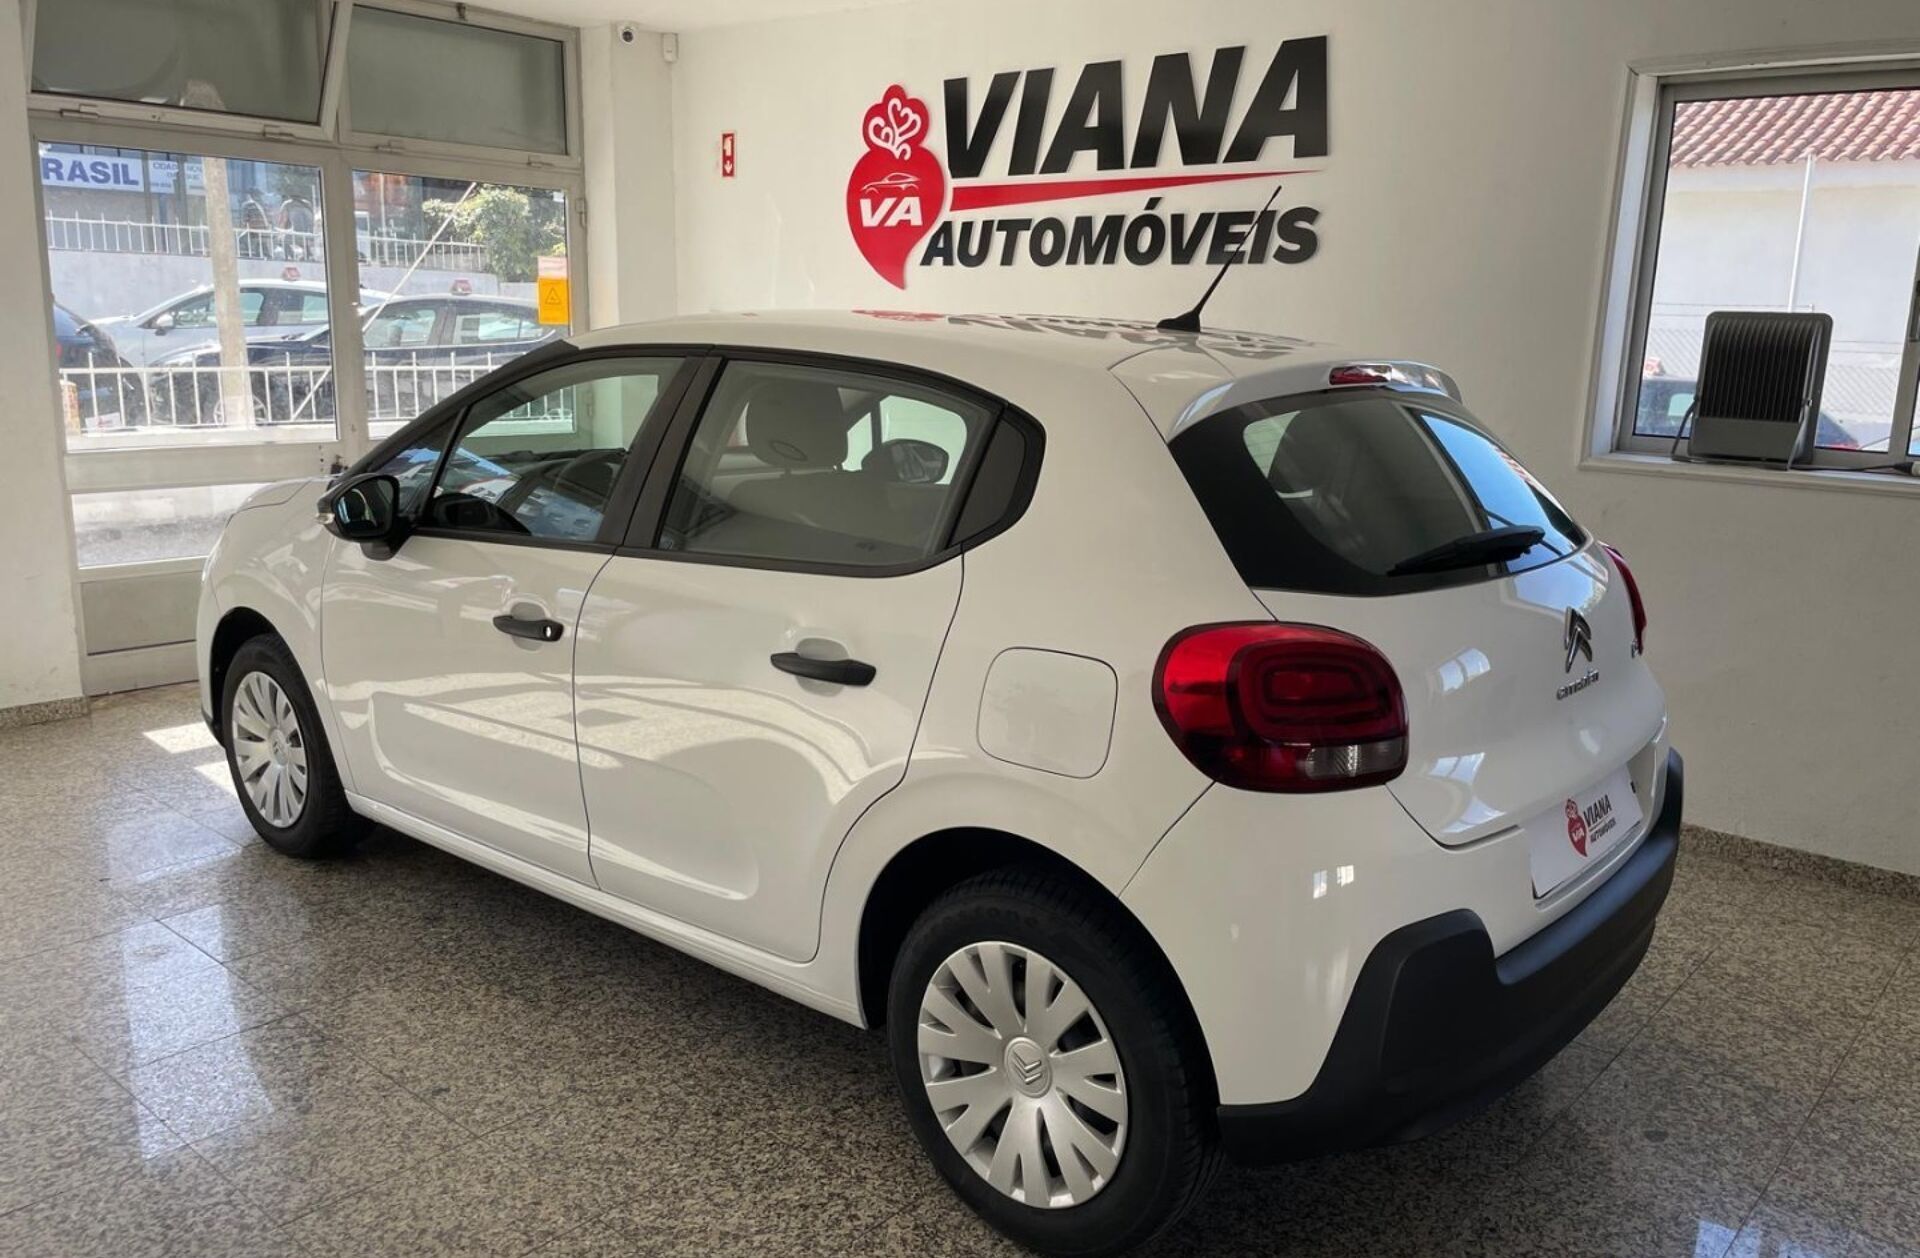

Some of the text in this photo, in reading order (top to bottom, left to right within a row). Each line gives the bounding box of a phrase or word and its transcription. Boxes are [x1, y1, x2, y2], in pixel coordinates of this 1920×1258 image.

[943, 35, 1328, 180] VIANA
[859, 196, 924, 229] VA
[919, 197, 1321, 269] AUTOMÓVEIS
[1583, 794, 1612, 828] VIANA
